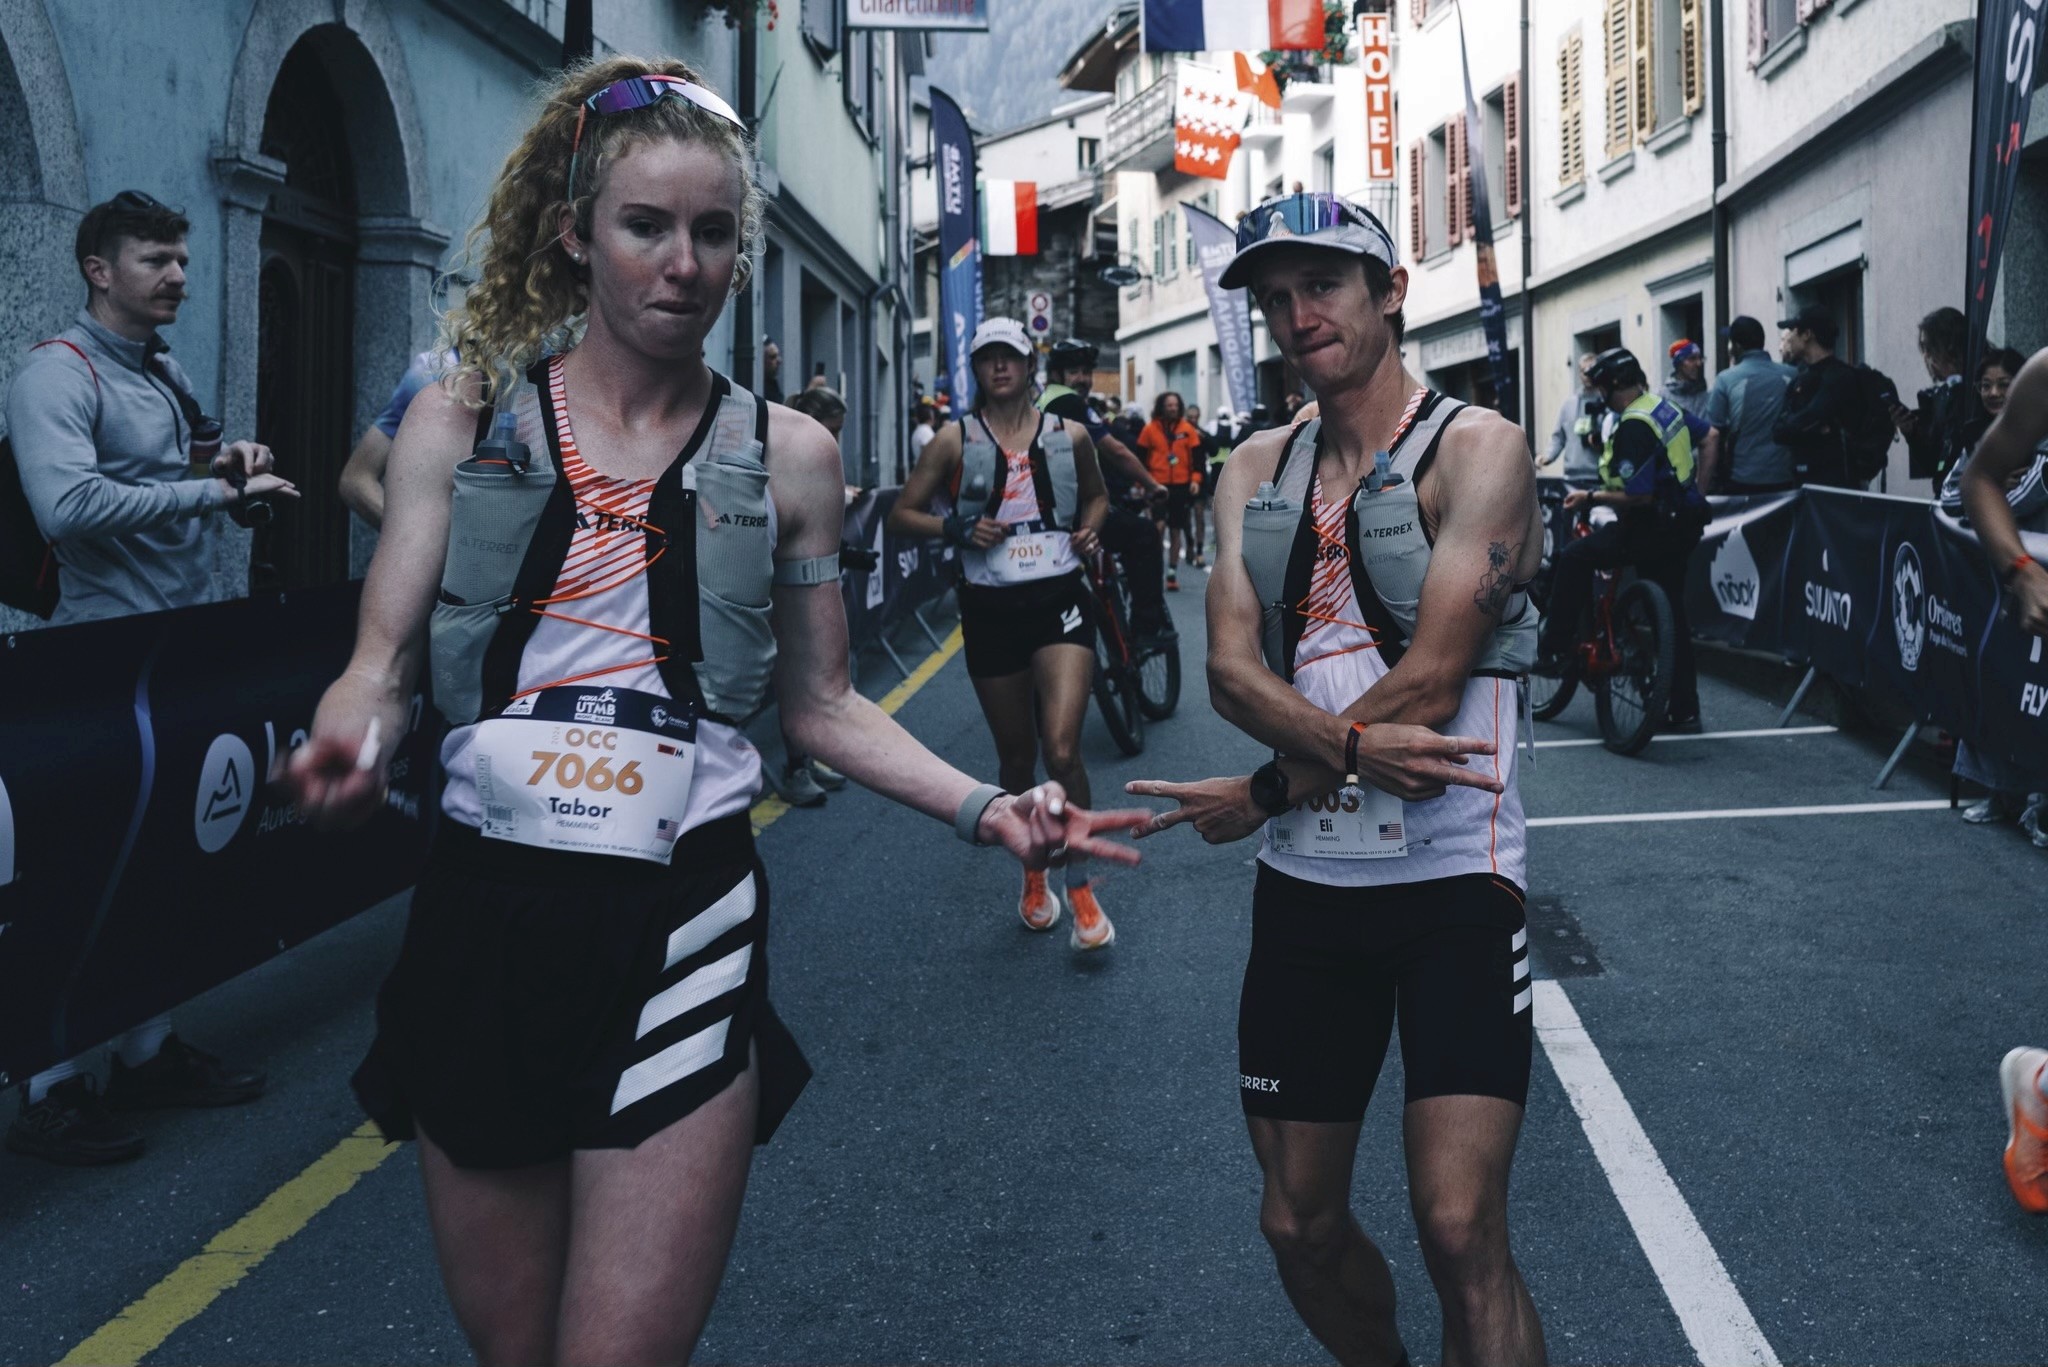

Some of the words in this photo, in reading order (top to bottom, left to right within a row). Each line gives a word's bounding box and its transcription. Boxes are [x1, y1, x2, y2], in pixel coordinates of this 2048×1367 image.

[1363, 18, 1391, 177] HOTEL
[733, 513, 769, 528] TERRE
[1373, 521, 1413, 538] TERREX
[1007, 544, 1043, 559] 7015
[575, 701, 616, 716] UTMB
[565, 727, 618, 750] OCC
[526, 750, 643, 795] 7066
[549, 796, 612, 818] Tabor
[1319, 818, 1333, 833] Eli
[1241, 1074, 1281, 1093] ERREX
